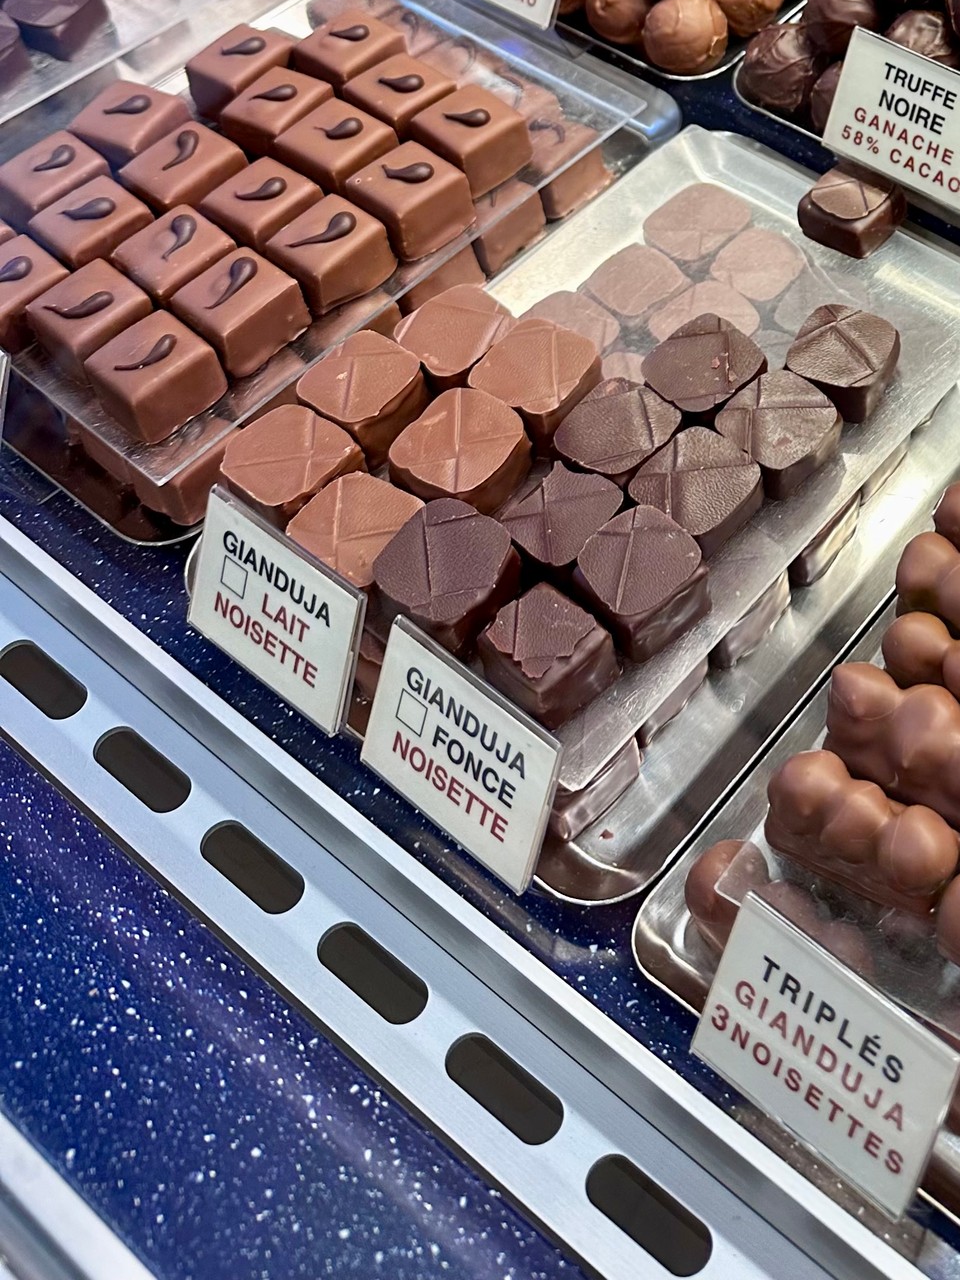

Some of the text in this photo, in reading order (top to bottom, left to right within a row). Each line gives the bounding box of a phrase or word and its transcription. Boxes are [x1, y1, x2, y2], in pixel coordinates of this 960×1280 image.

[878, 89, 946, 136] NOIRE
[884, 61, 958, 111] TRUFFE
[841, 124, 880, 155] 58%
[853, 107, 954, 166] GANACHE
[222, 530, 332, 628] GIANDUJA
[261, 592, 311, 643] LAIT
[213, 590, 319, 689] NOISETTE
[406, 666, 526, 780] GIANDUJA
[431, 724, 517, 810] FONCE
[391, 730, 509, 844] NOISETTE
[734, 979, 905, 1133] GIANDUJA
[759, 954, 905, 1084] TRIPLÉS
